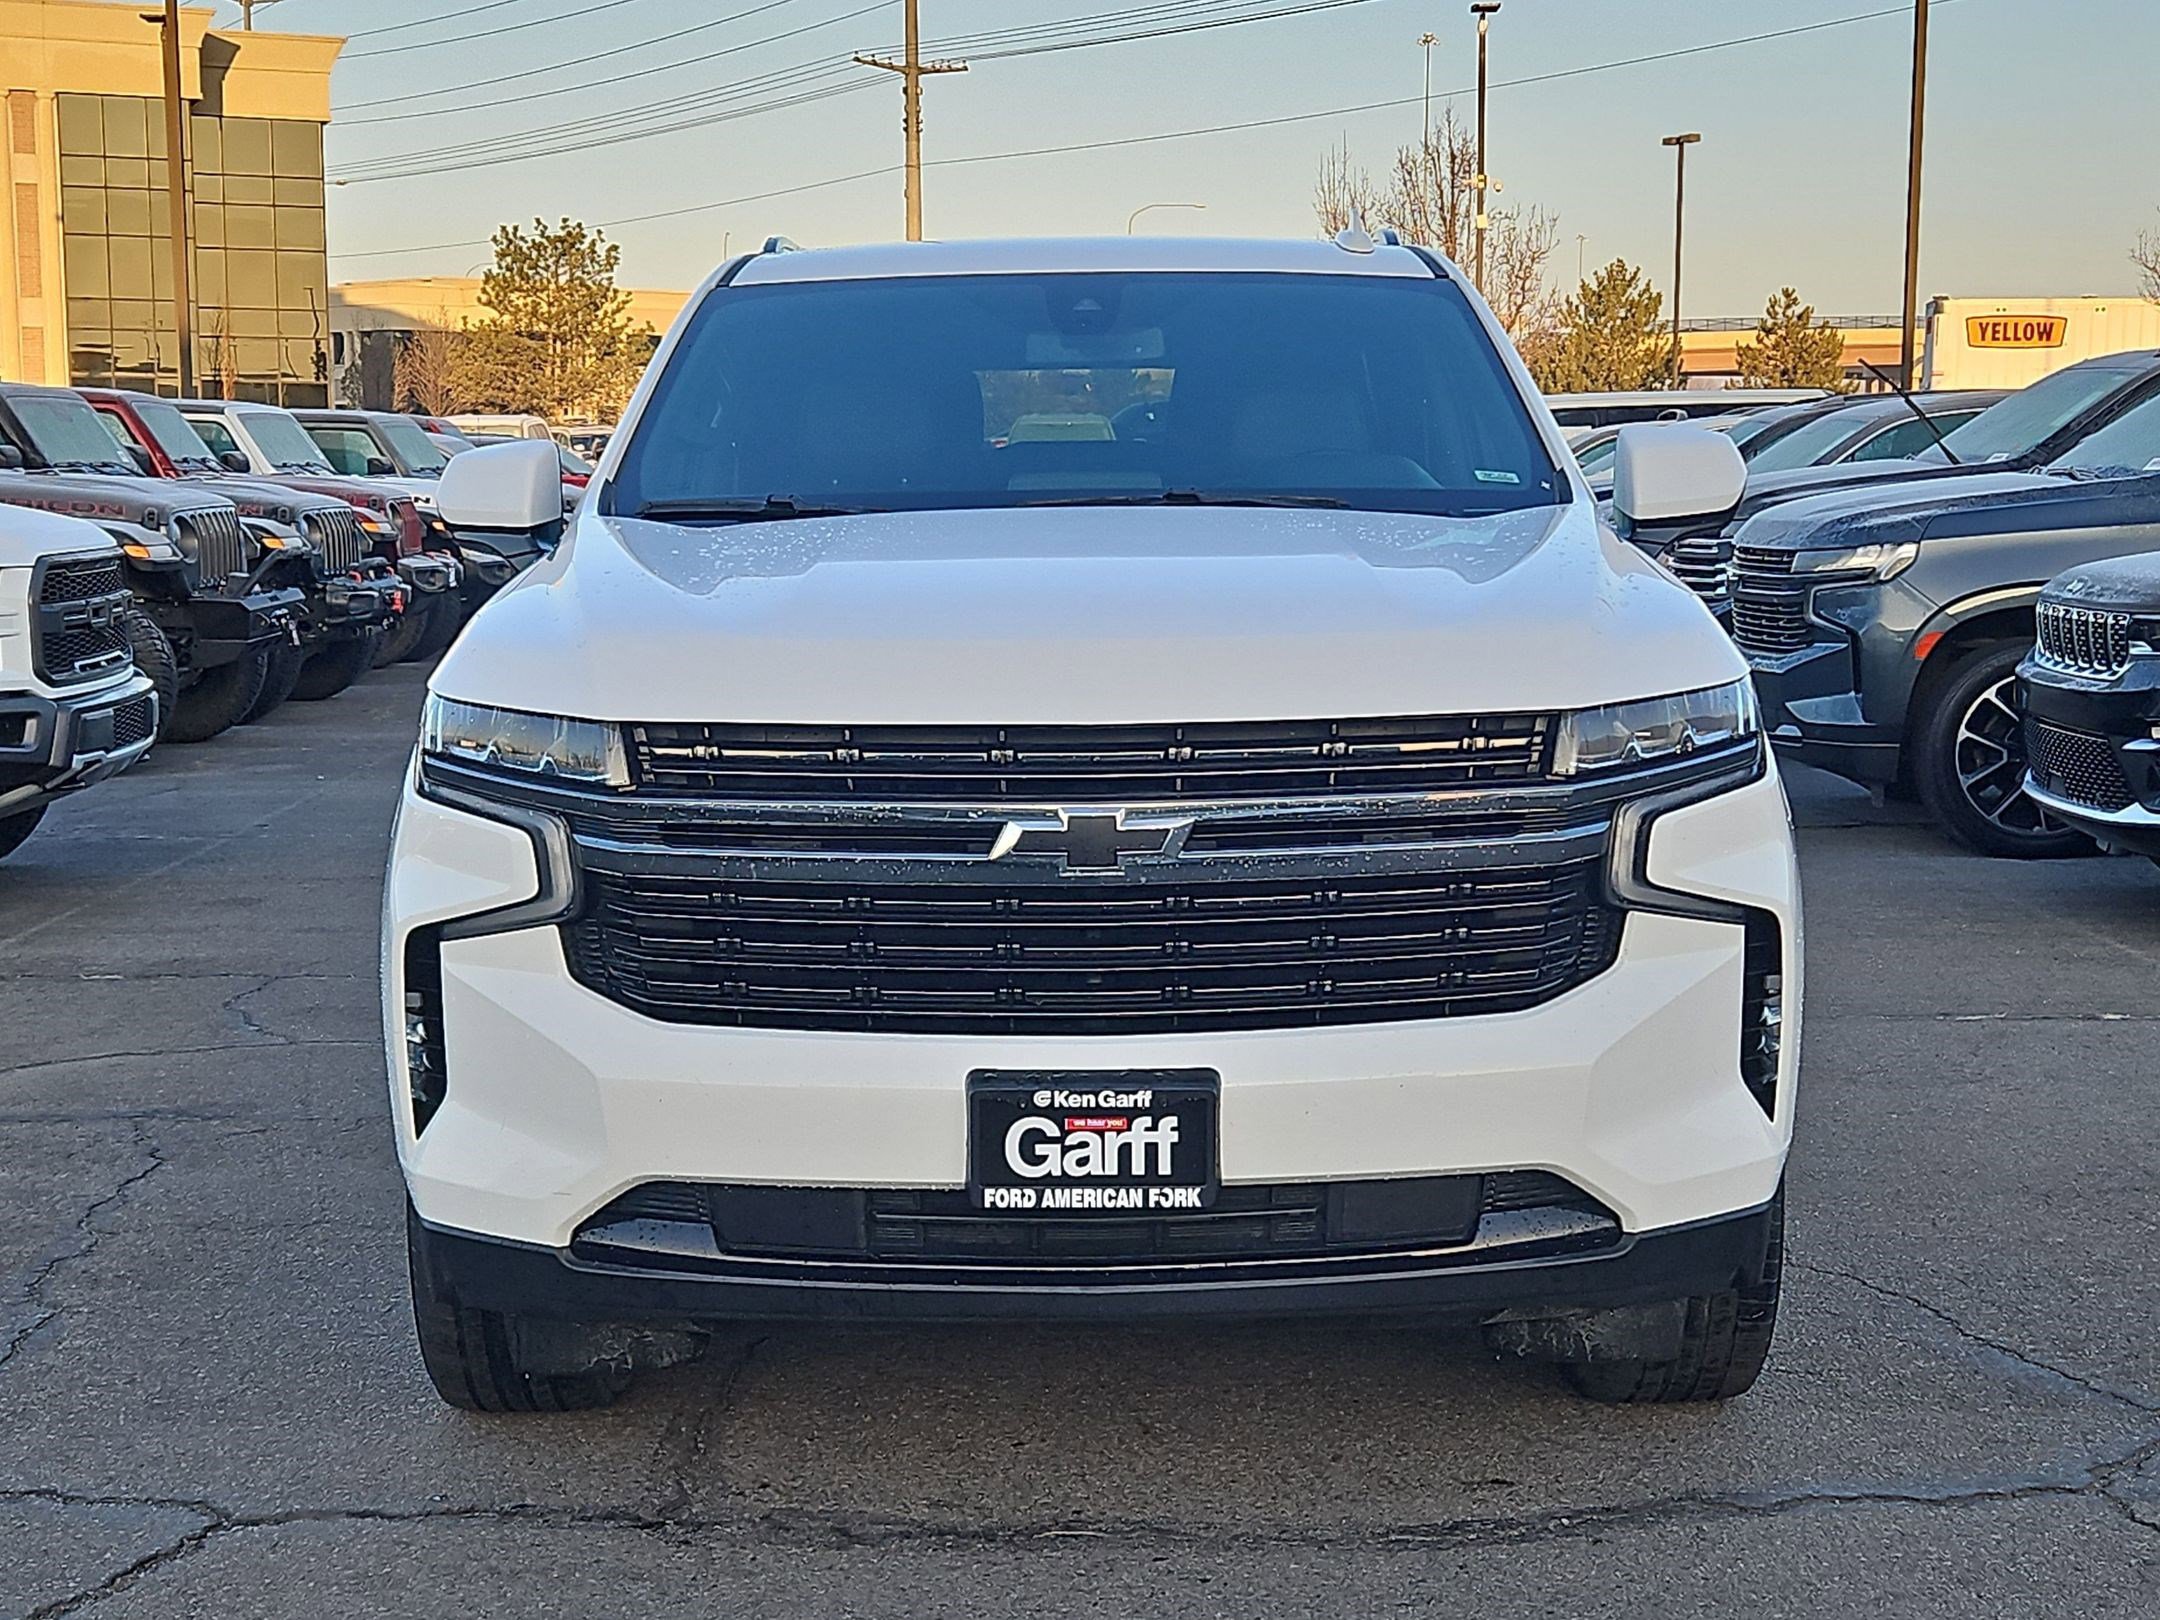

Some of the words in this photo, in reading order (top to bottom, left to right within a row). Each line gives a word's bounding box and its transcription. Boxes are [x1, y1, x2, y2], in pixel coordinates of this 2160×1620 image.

[1978, 321, 2055, 342] YELLOW
[1054, 1090, 1097, 1108] Ken
[1098, 1090, 1152, 1108] Garff
[1087, 1118, 1106, 1126] hear
[1107, 1119, 1123, 1128] you
[1004, 1115, 1178, 1177] Garff
[984, 1187, 1036, 1208] FORD
[1041, 1187, 1143, 1208] AMERICAN
[1149, 1187, 1202, 1208] FORK
